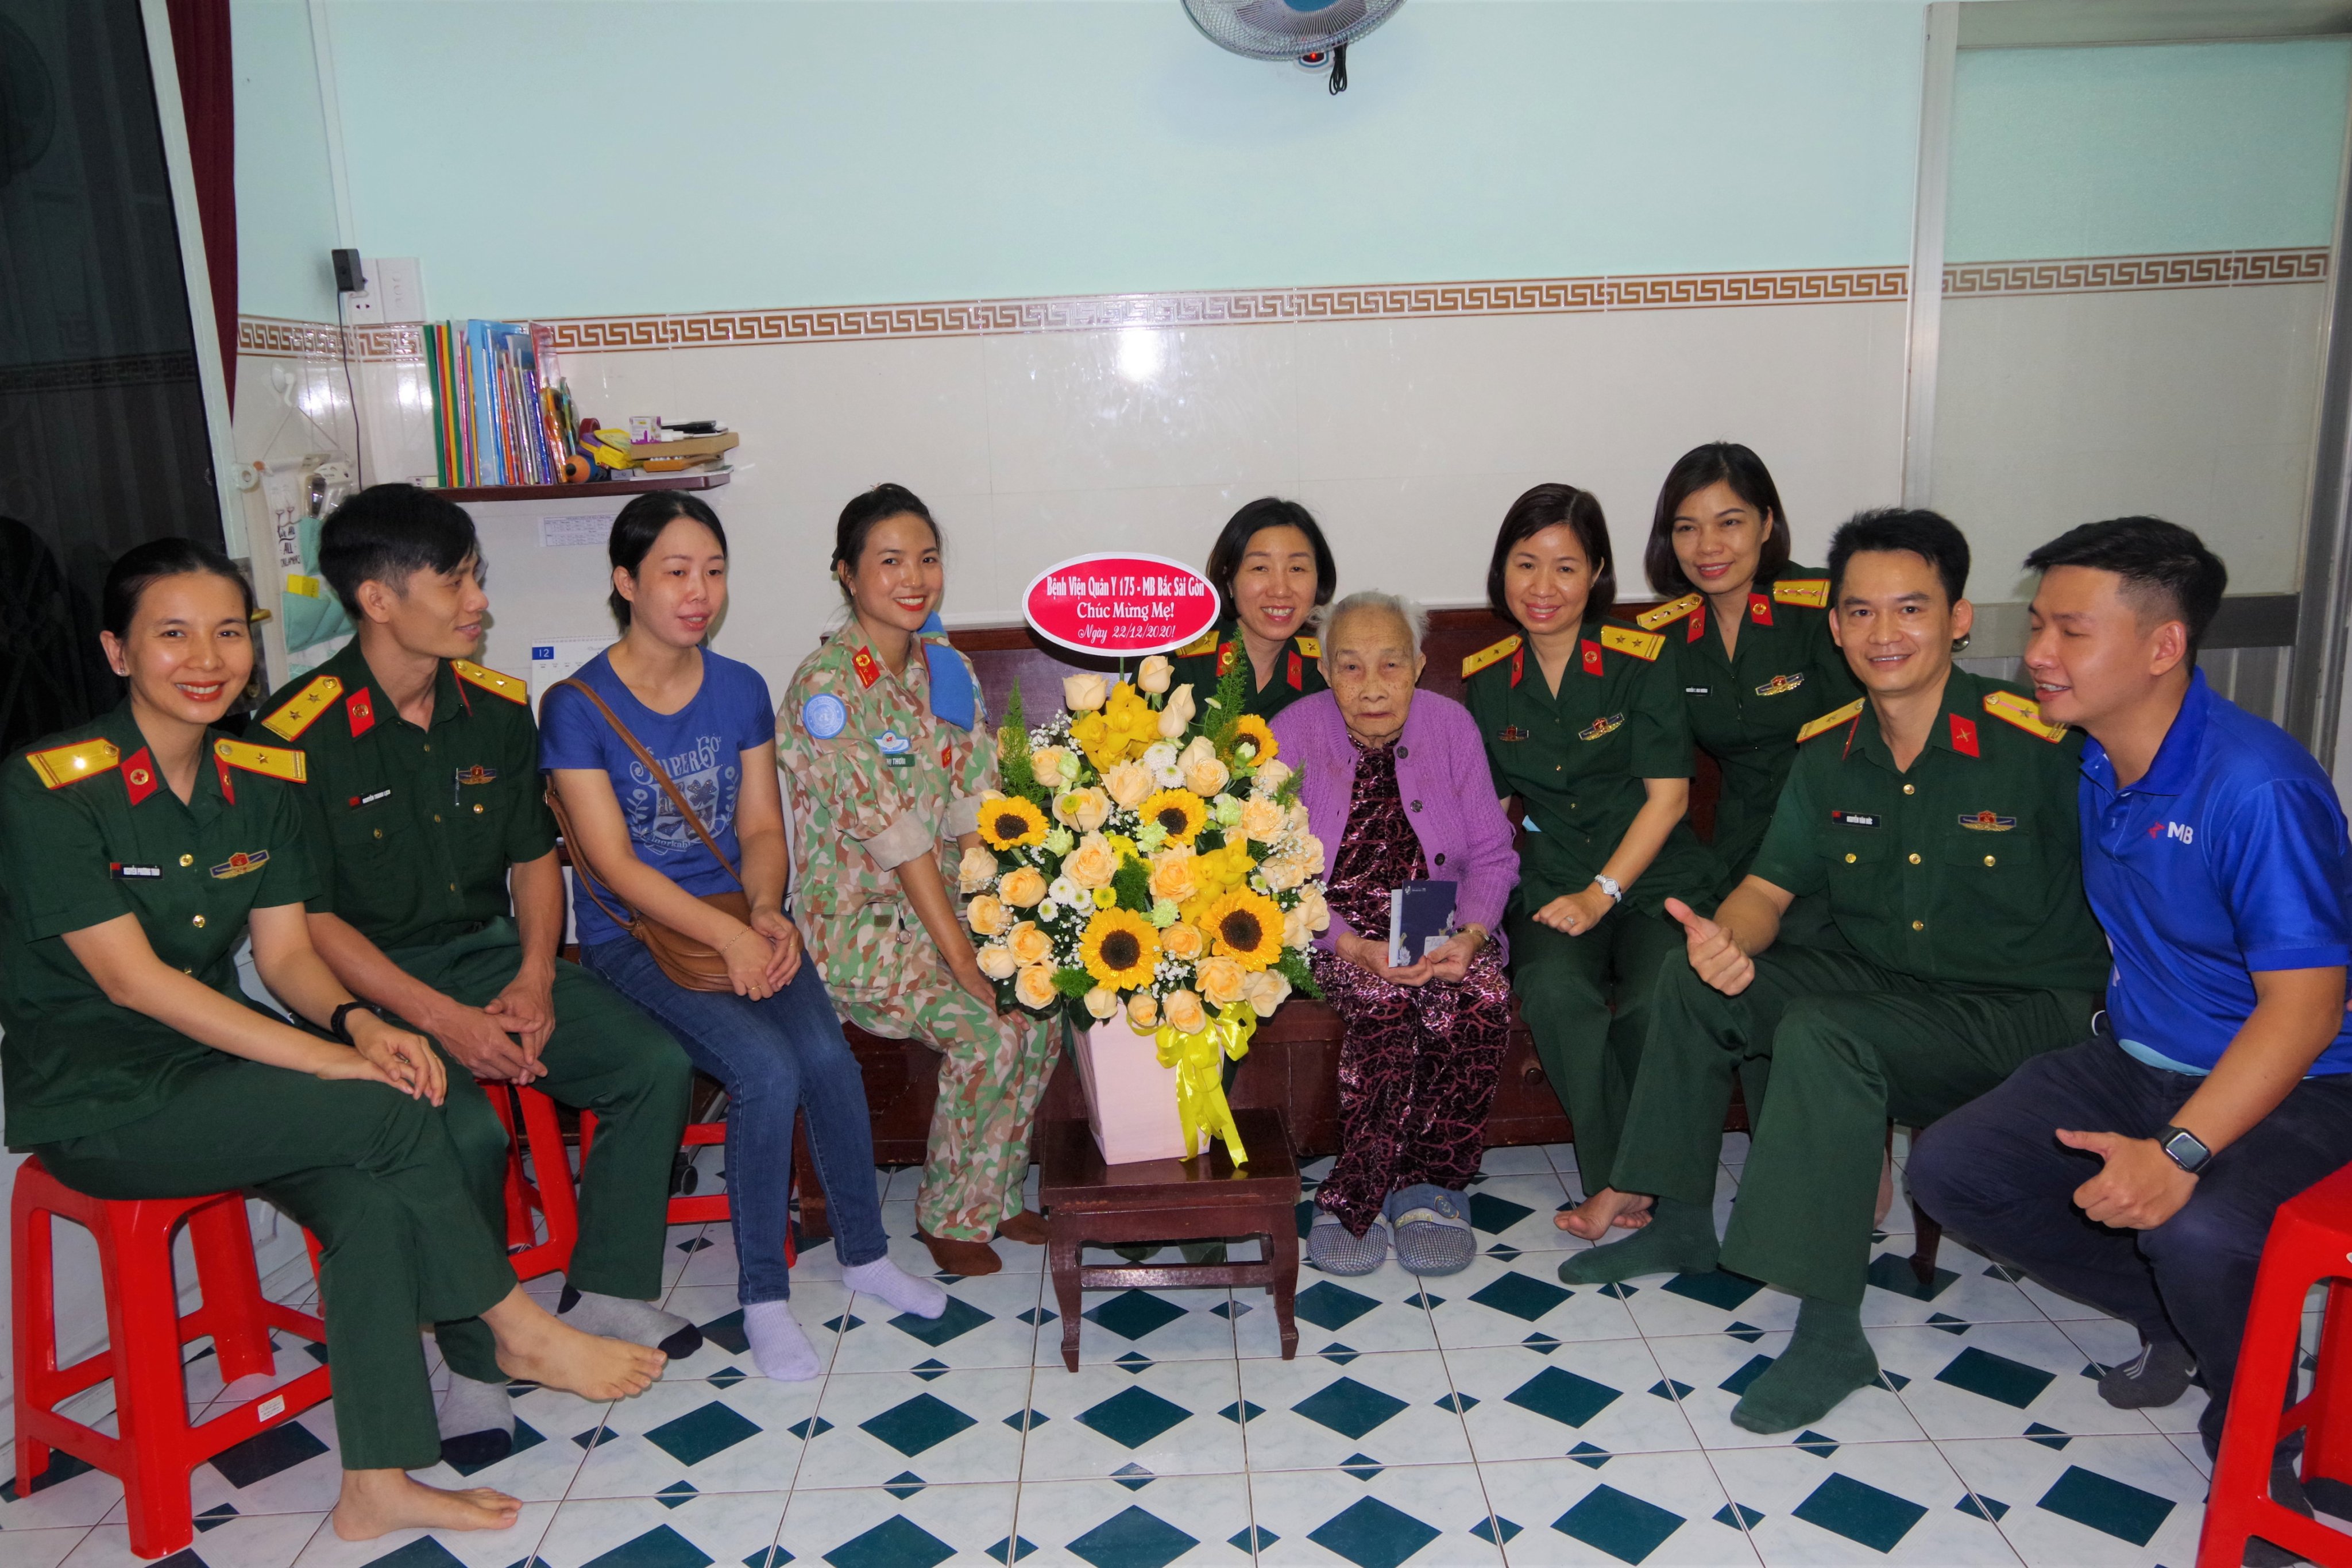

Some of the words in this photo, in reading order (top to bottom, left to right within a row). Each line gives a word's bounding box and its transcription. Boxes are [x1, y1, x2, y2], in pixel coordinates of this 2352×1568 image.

[1046, 576, 1067, 600] Bệnh
[1068, 576, 1086, 600] Viện
[1088, 576, 1109, 598] Quân
[1111, 576, 1117, 596] Y
[1119, 576, 1135, 596] 175
[1142, 576, 1156, 596] MB
[1157, 574, 1172, 596] Bắc
[1173, 576, 1186, 596] Sài
[1188, 576, 1204, 596] Gòn
[1076, 602, 1111, 618] Chúc
[1113, 602, 1149, 621] Mừng
[1150, 601, 1175, 621] Mẹ!
[1077, 624, 1108, 644] Ngày
[1111, 623, 1176, 639] 22/12/2020!
[539, 648, 550, 658] 12
[2167, 821, 2193, 845] MB
